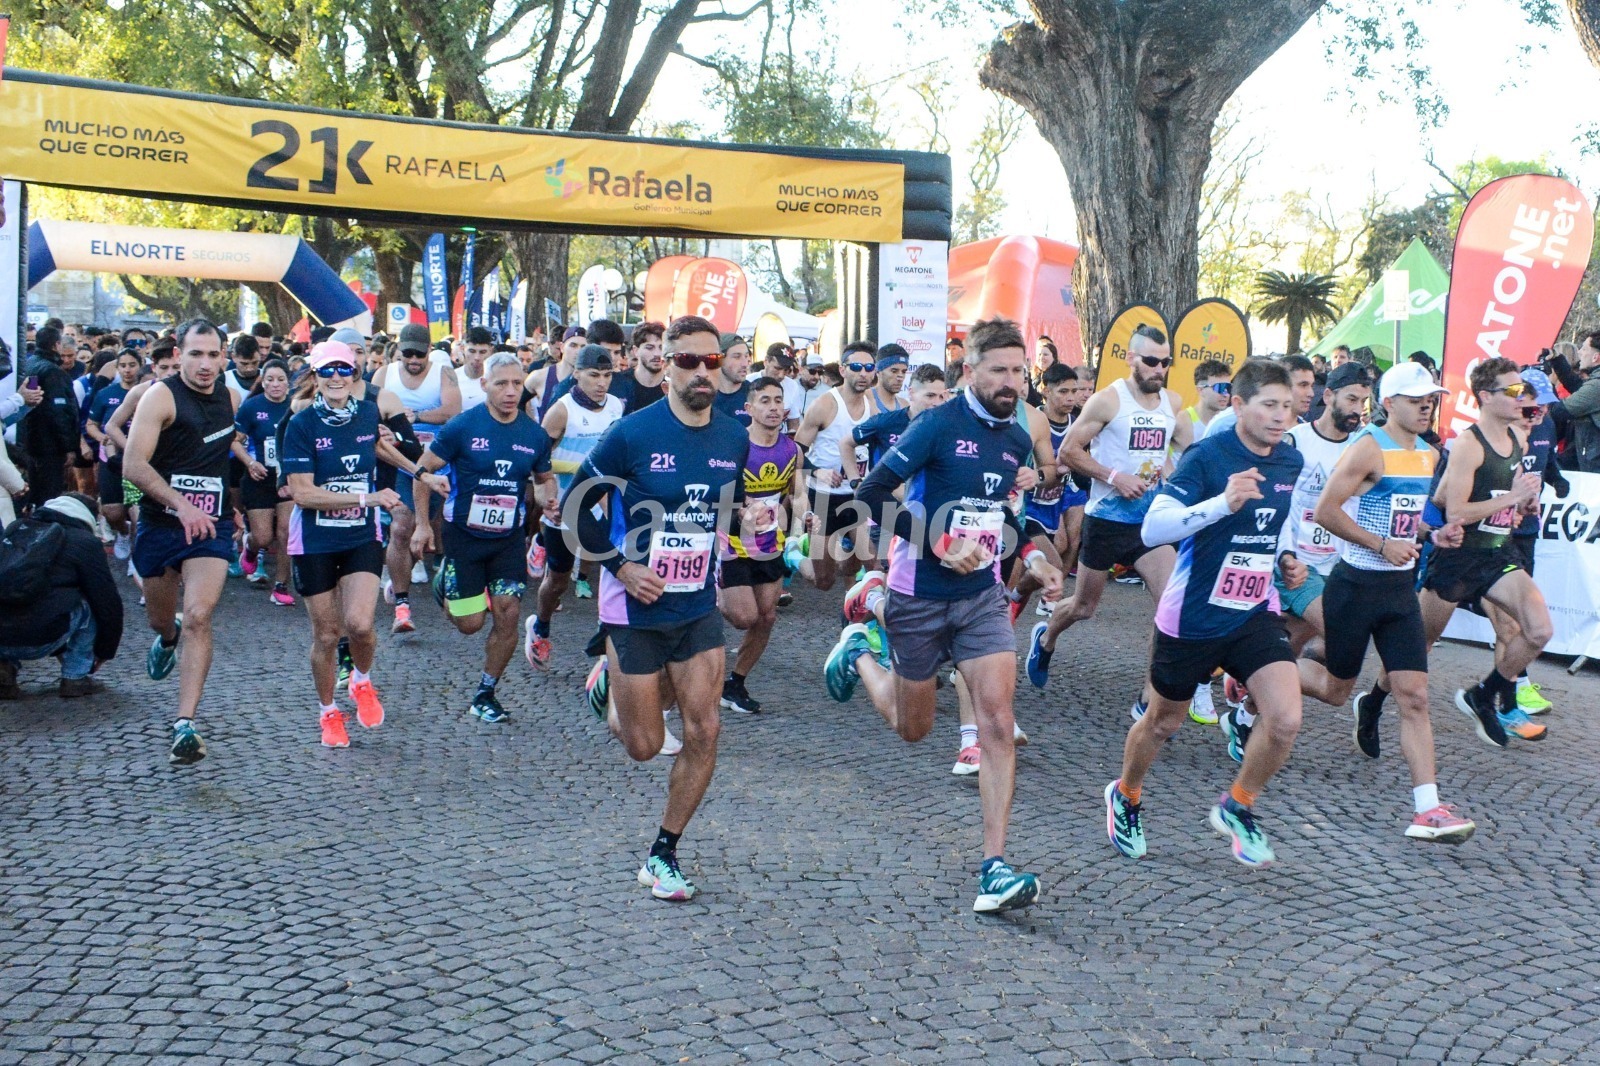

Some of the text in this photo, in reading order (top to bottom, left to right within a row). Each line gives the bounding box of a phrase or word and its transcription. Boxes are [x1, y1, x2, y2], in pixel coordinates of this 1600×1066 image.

[44, 119, 185, 144] MUCHO MÁS
[39, 138, 189, 164] QUE CORRER
[246, 119, 507, 194] 21K RAFAELA
[588, 166, 712, 203] Rafaela
[779, 184, 839, 198] MUCHO
[633, 203, 712, 216] Gobierno Municipal
[776, 200, 882, 217] QUE CORRER
[1541, 196, 1582, 270] .net
[192, 250, 251, 262] SEGUROS
[894, 266, 933, 274] MEGATONE
[428, 244, 446, 314] ELNORTE
[722, 269, 741, 305] .net
[902, 316, 925, 329] ilolay
[1180, 343, 1235, 365] Rafaela
[1133, 416, 1154, 425] 10K
[472, 437, 489, 449] 21K
[1133, 430, 1163, 448] 1050
[955, 440, 978, 454] 21K
[650, 453, 675, 469] 21K
[716, 460, 736, 468] Rafaela
[177, 478, 205, 488] 10K
[325, 484, 351, 493] 10K
[479, 478, 517, 488] MEGATONE
[481, 508, 505, 526] 164
[661, 512, 715, 522] MEGATONE
[960, 515, 982, 526] 5K
[659, 536, 694, 548] 10K
[1230, 534, 1278, 544] MEGATONE
[656, 555, 704, 580] 5199
[1231, 555, 1253, 567] 5K
[1222, 572, 1265, 599] 5190
